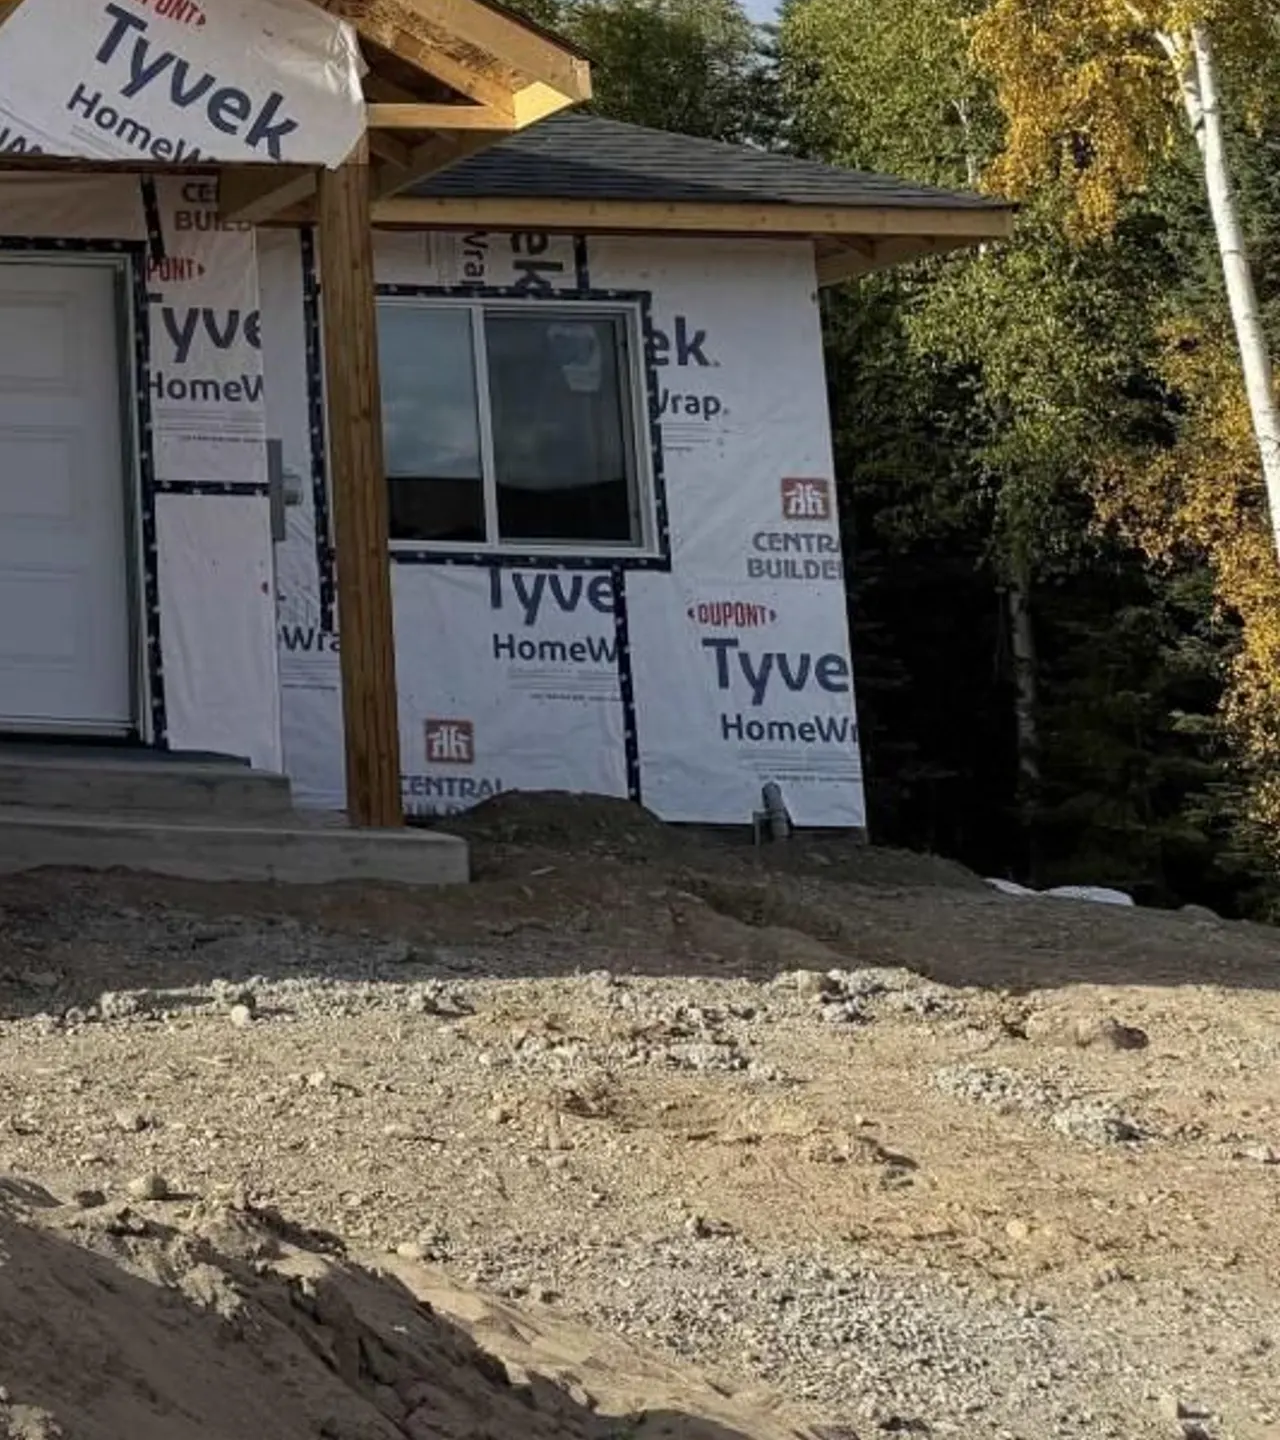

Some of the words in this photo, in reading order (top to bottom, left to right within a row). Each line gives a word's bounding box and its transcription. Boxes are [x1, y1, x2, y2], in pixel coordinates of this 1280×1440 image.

[95, 2, 299, 161] Tyvek
[66, 83, 214, 164] HomeW
[147, 256, 196, 283] PONT
[149, 371, 263, 403] HomeW
[747, 558, 843, 580] BUILDE
[490, 568, 615, 625] Tyve
[697, 602, 767, 628] DUPONT
[493, 633, 619, 663] HomeW
[702, 638, 849, 706] Tyve
